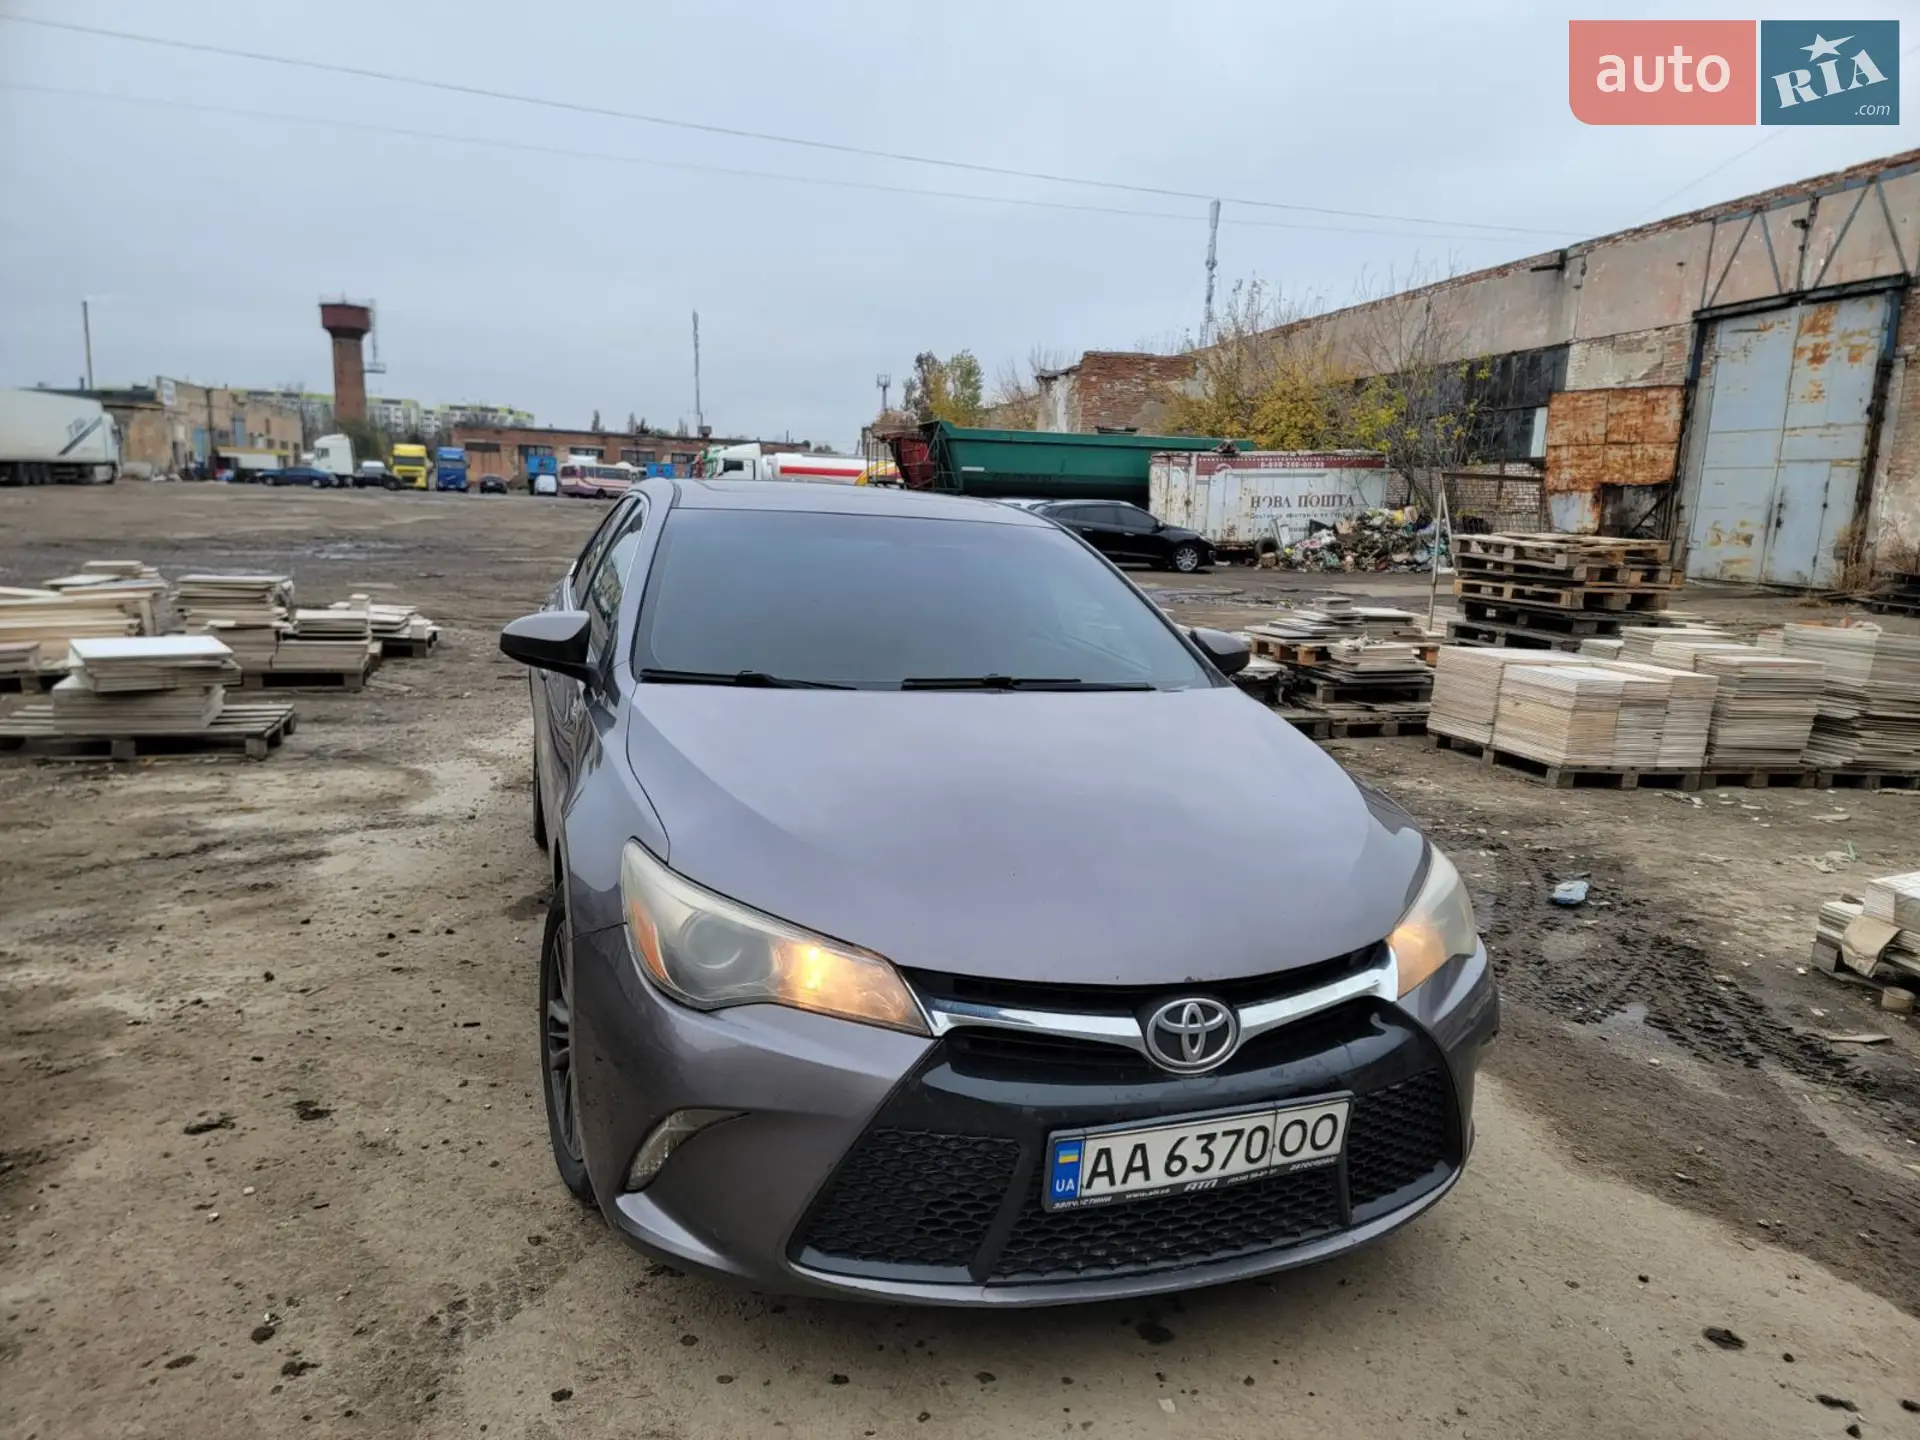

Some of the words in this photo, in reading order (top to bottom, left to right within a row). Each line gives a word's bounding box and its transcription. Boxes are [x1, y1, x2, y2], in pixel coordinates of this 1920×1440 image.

[1250, 495, 1292, 508] НОВА
[1297, 493, 1354, 508] ПОШТА
[1085, 1142, 1151, 1190] AA
[1163, 1124, 1270, 1179] 6370
[1279, 1112, 1340, 1158] OO
[1055, 1178, 1075, 1192] UA
